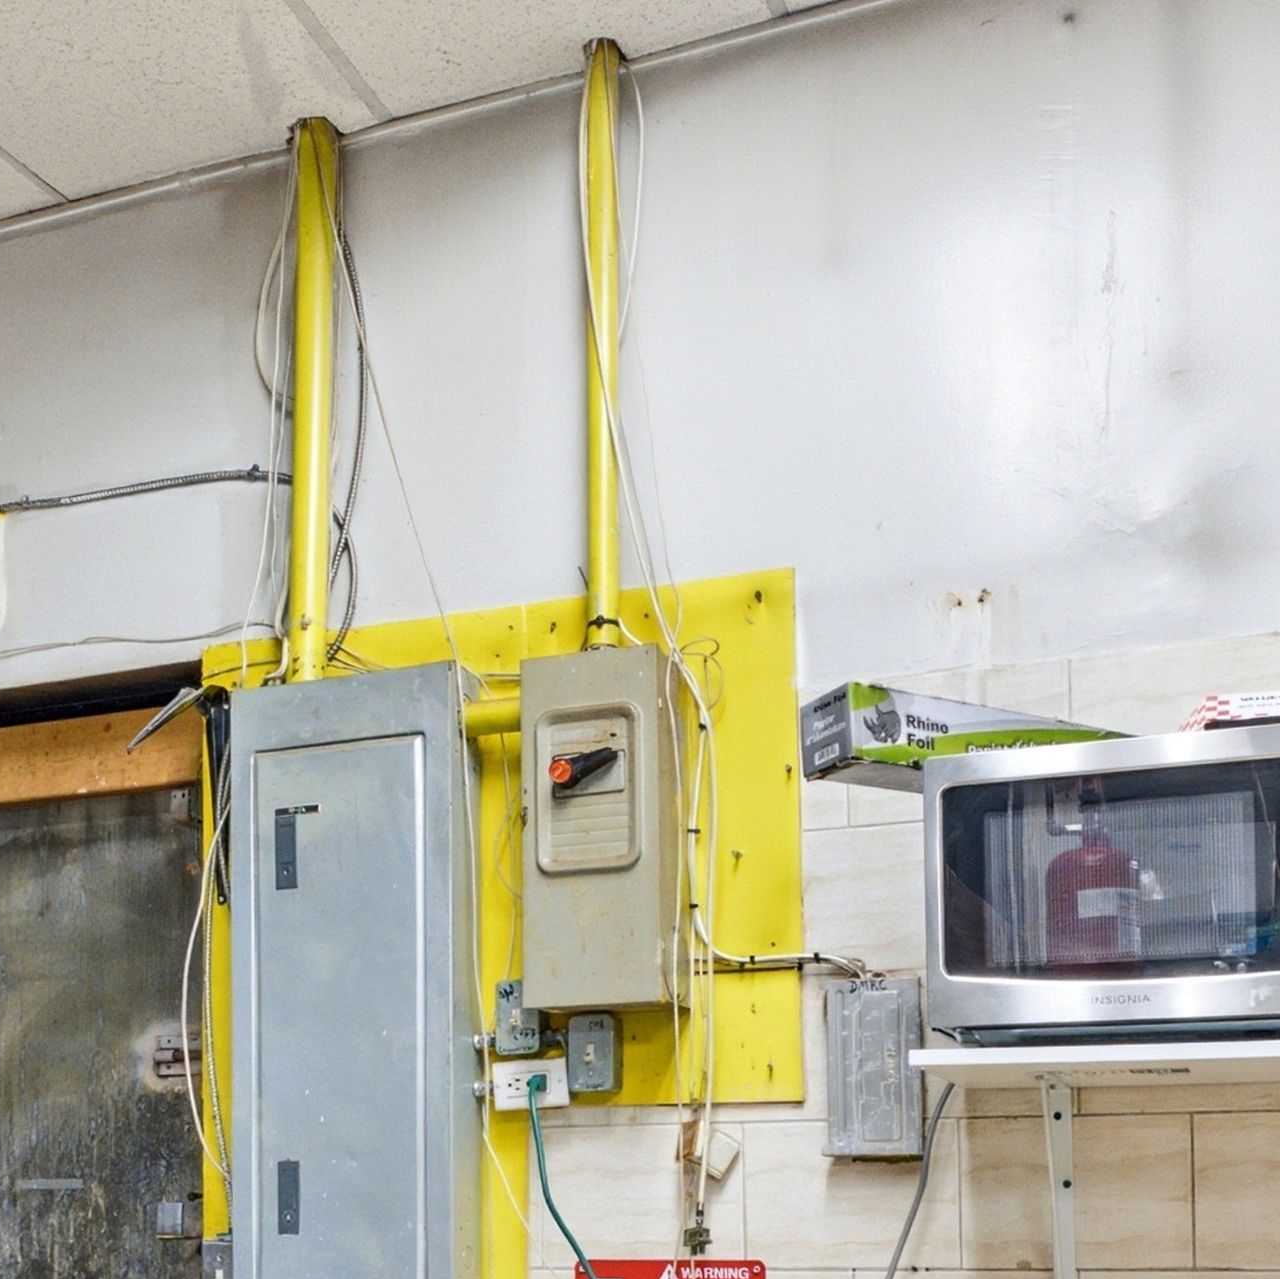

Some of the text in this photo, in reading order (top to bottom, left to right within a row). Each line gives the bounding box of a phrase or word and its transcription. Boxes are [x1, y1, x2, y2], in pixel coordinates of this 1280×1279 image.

[906, 713, 949, 734] Rhino
[907, 733, 935, 751] Foil
[1090, 993, 1151, 1006] INSIGNIA
